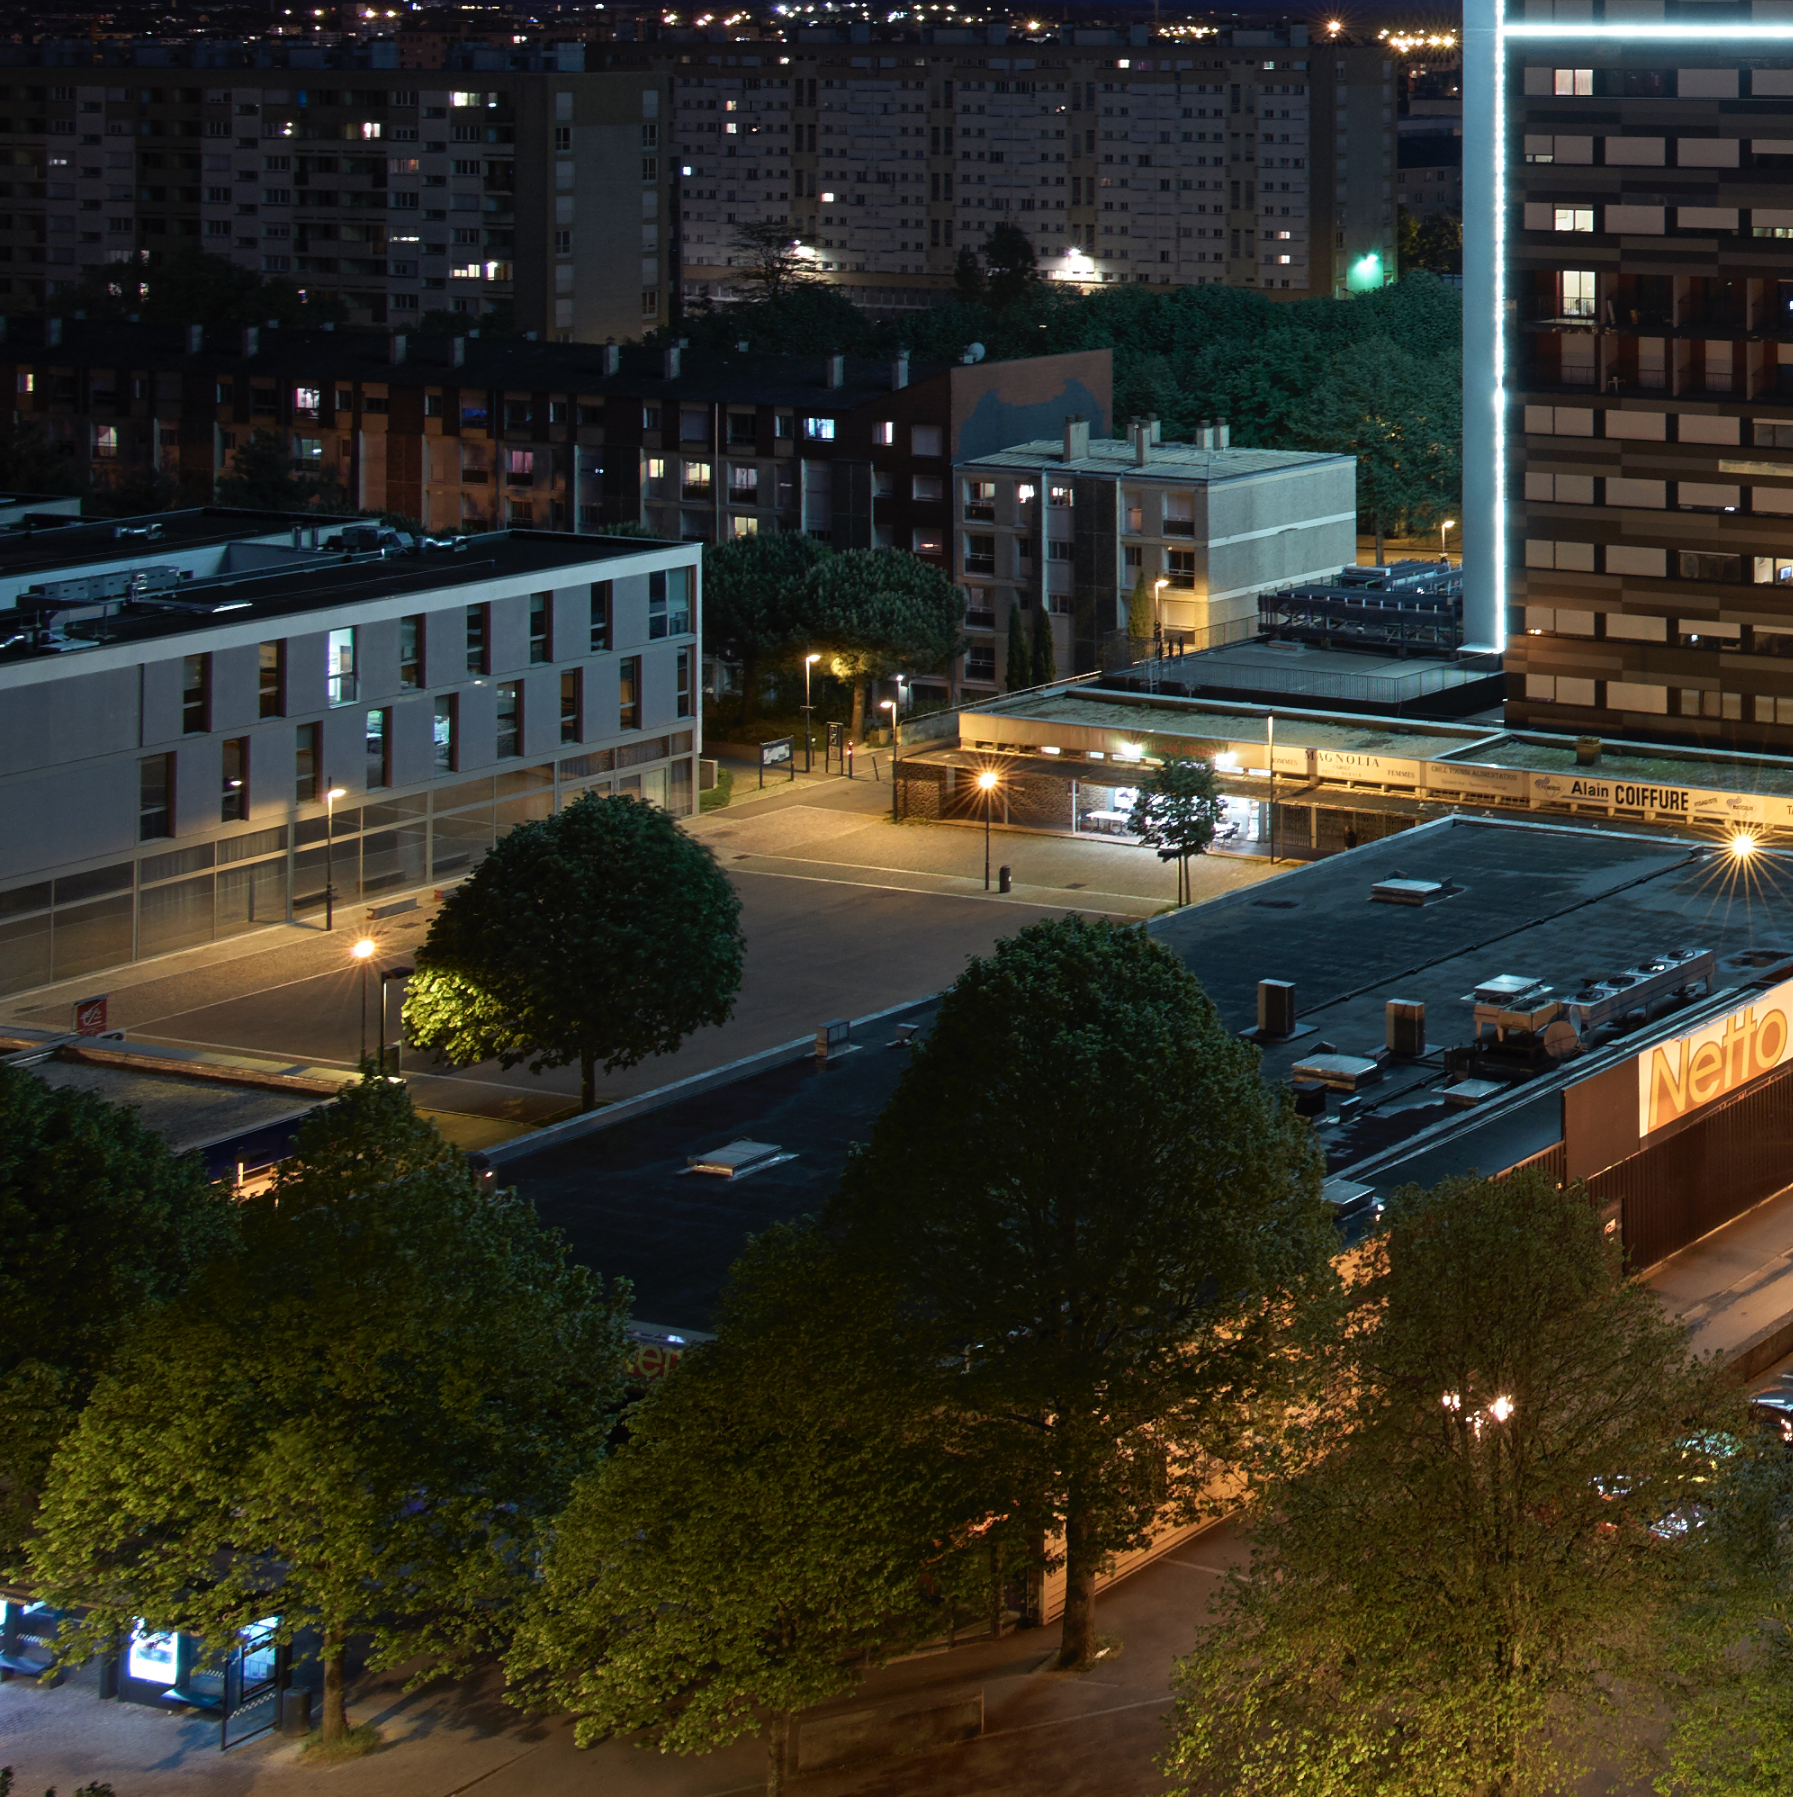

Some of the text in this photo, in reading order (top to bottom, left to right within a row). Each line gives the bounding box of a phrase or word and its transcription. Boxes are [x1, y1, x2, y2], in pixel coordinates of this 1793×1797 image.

[1183, 744, 1222, 758] KEBA
[1304, 750, 1380, 767] MAGNOLIA
[1271, 757, 1298, 766] OMMES
[1387, 769, 1416, 779] FEMMES
[1571, 781, 1689, 811] Alain COIFFURE
[1649, 1006, 1788, 1129] Netto
